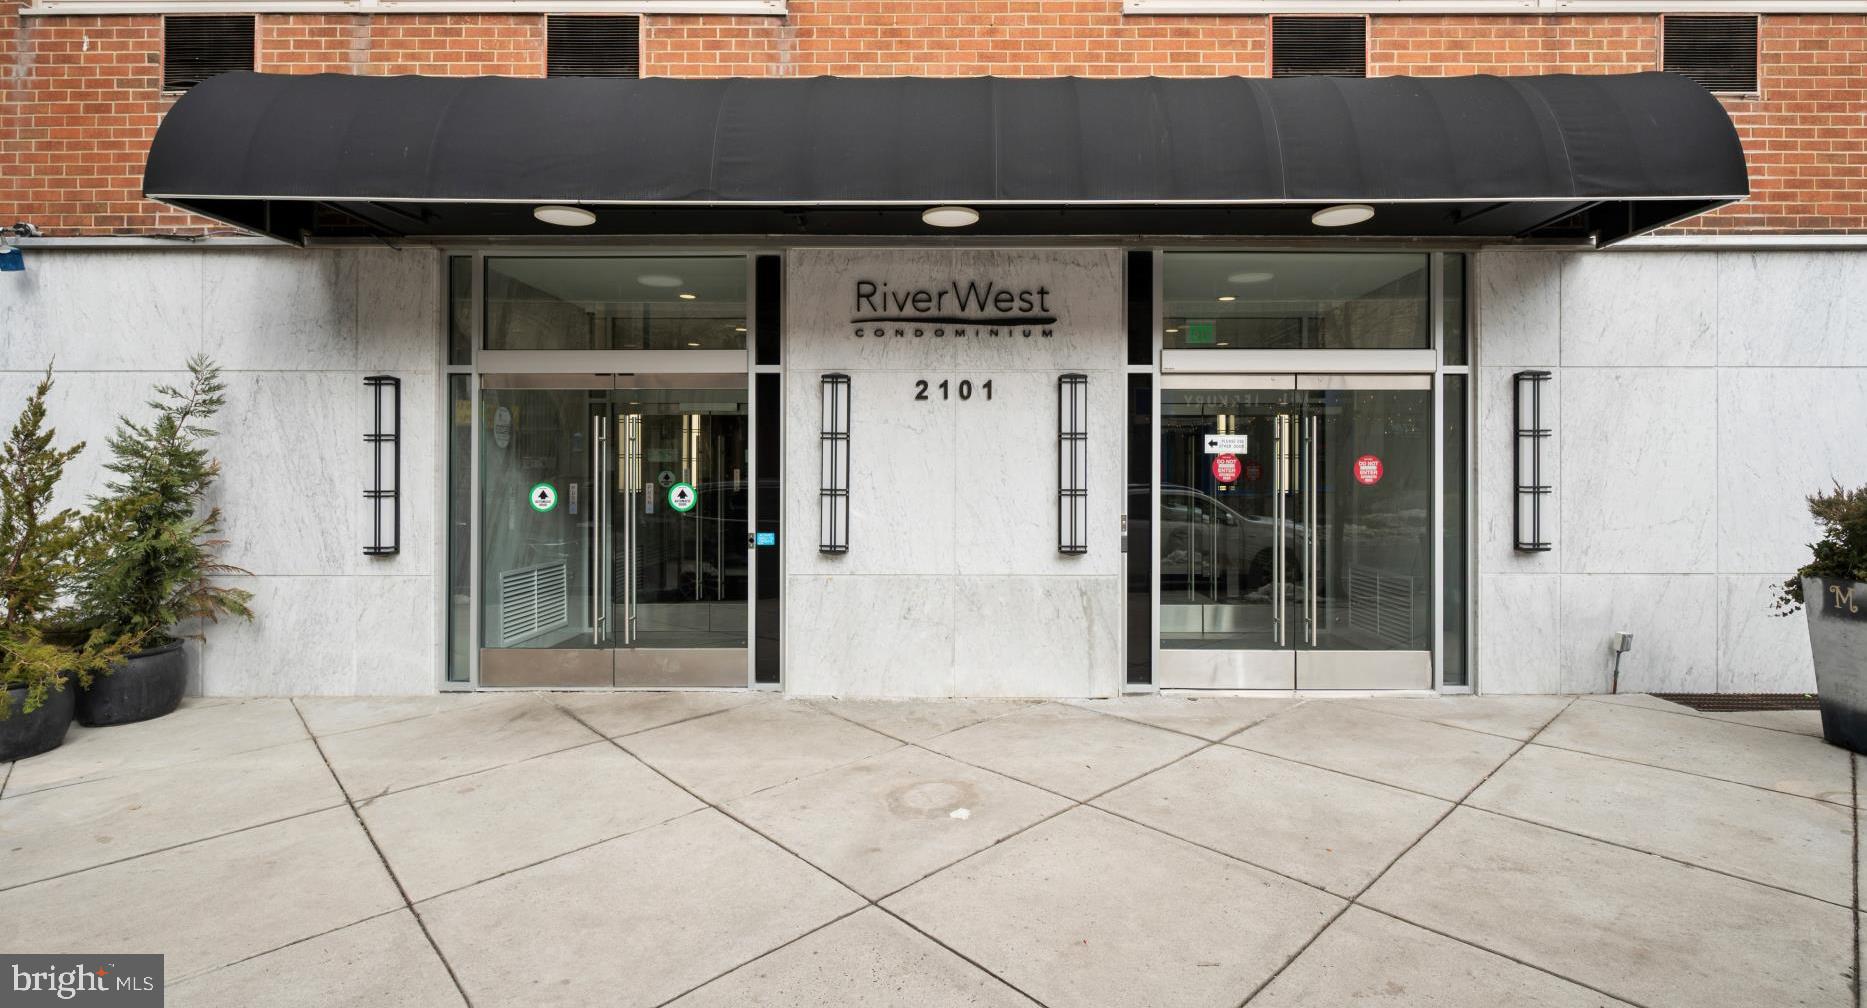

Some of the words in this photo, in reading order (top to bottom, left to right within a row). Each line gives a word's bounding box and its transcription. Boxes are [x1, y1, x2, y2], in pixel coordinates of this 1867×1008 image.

[856, 280, 1050, 313] RiverWest
[855, 328, 1054, 338] CONDOMINIUM
[914, 379, 993, 401] 2101
[1829, 585, 1858, 613] M
